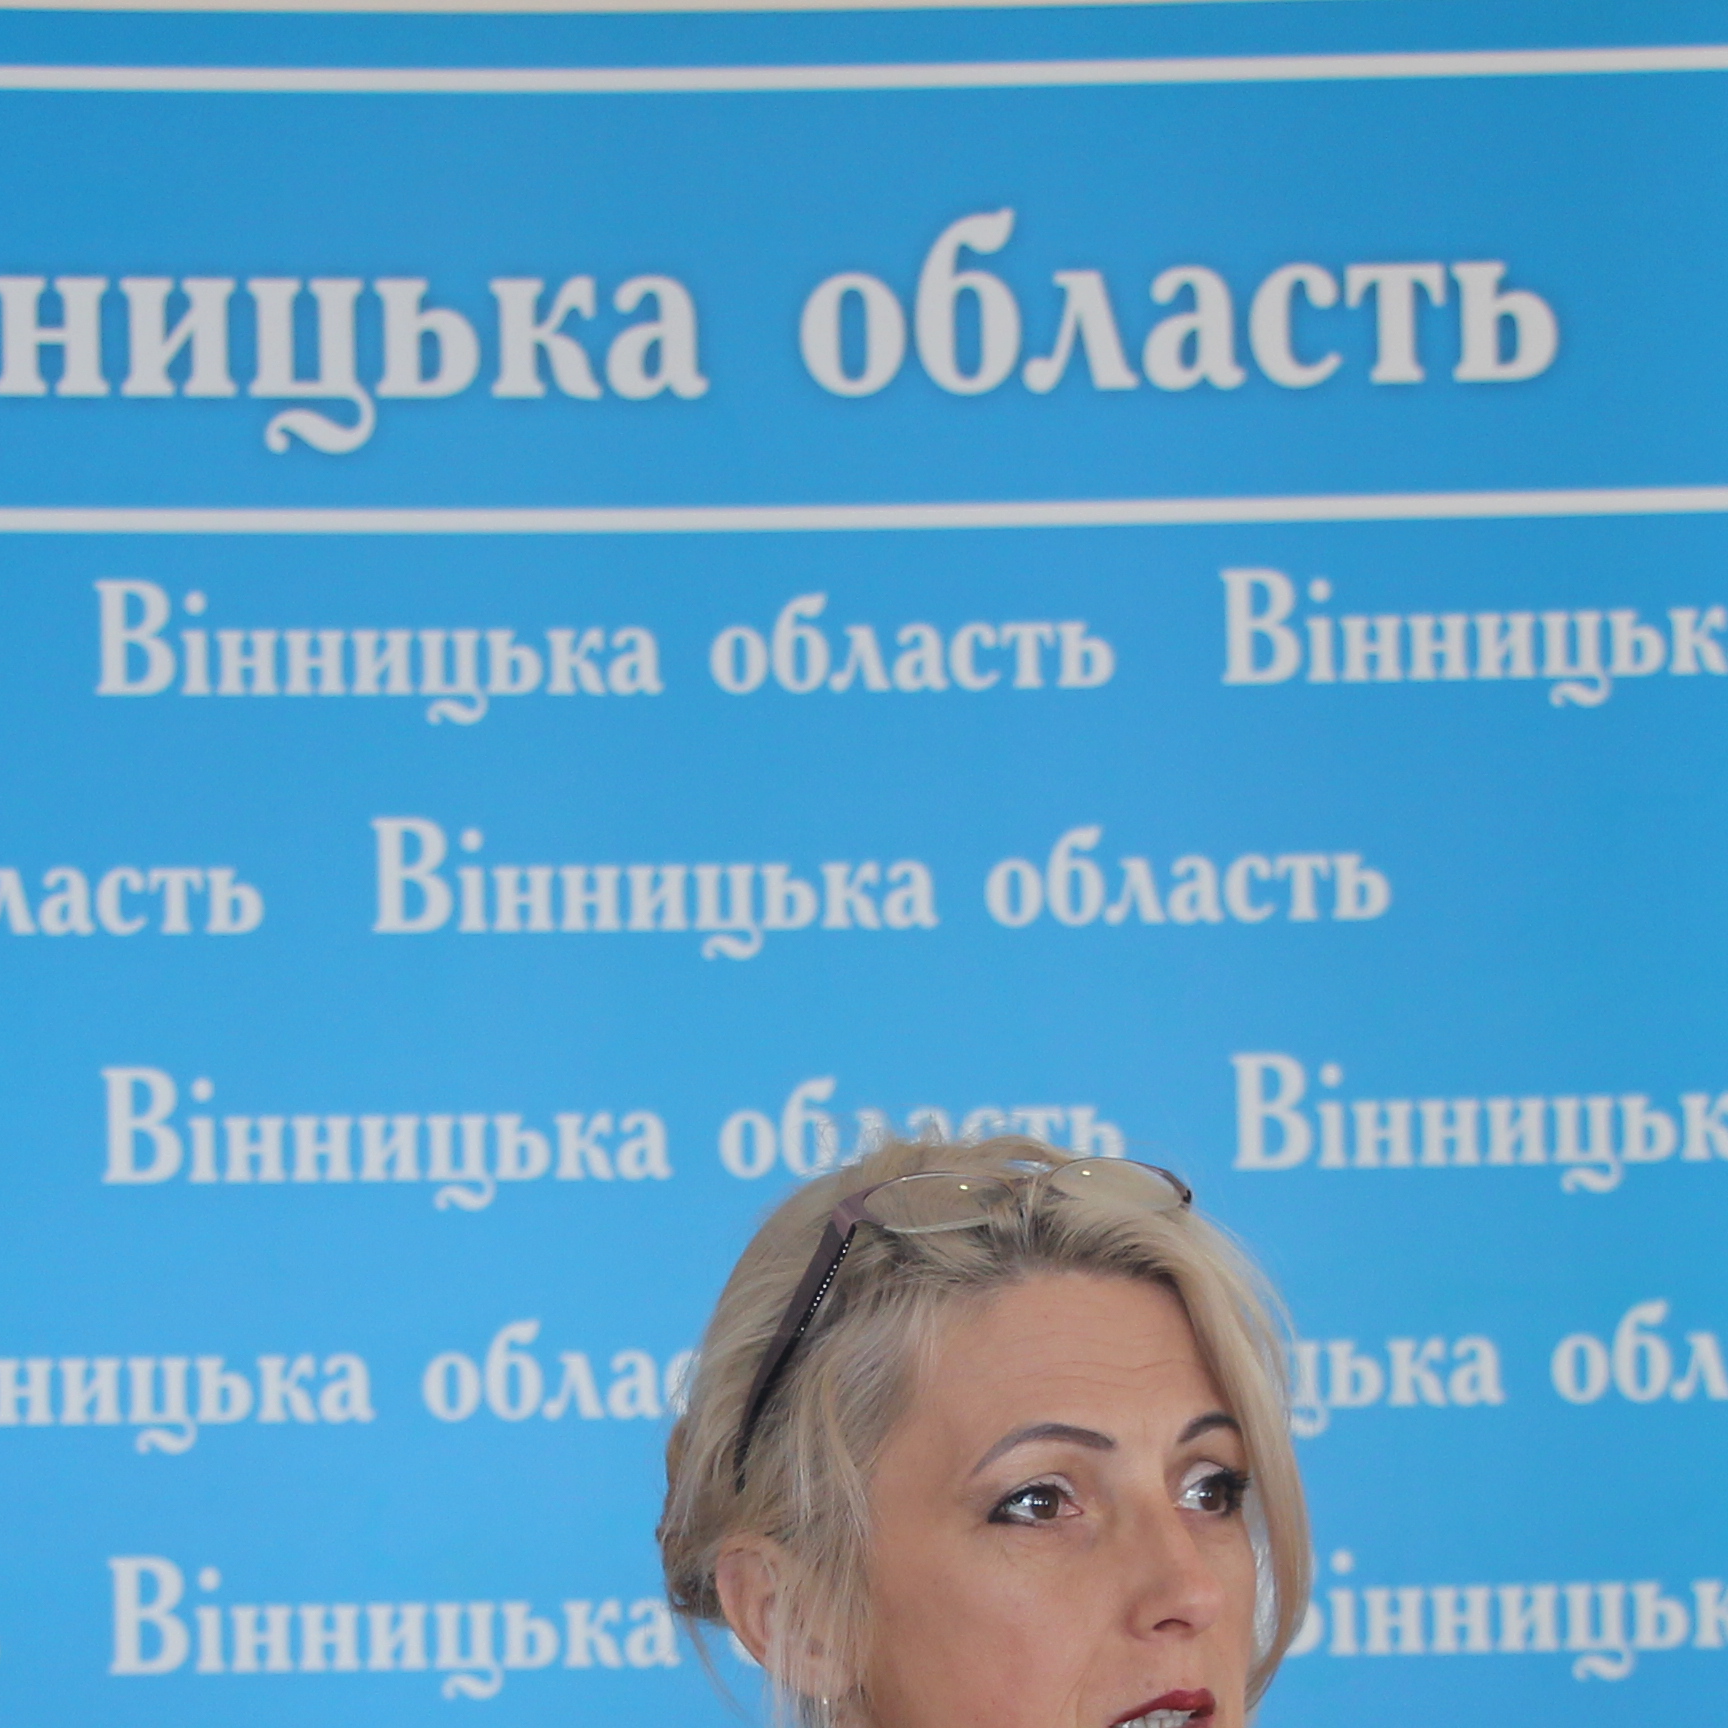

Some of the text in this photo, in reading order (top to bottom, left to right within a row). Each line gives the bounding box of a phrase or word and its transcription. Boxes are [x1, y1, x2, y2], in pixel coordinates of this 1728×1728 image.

[801, 209, 1557, 395] область
[96, 580, 1114, 723] Вінницька область
[373, 817, 1390, 958] Вінницька область
[103, 1067, 671, 1210] Вінницька
[423, 1317, 700, 1421] облас
[110, 1557, 680, 1698] Вінницька
